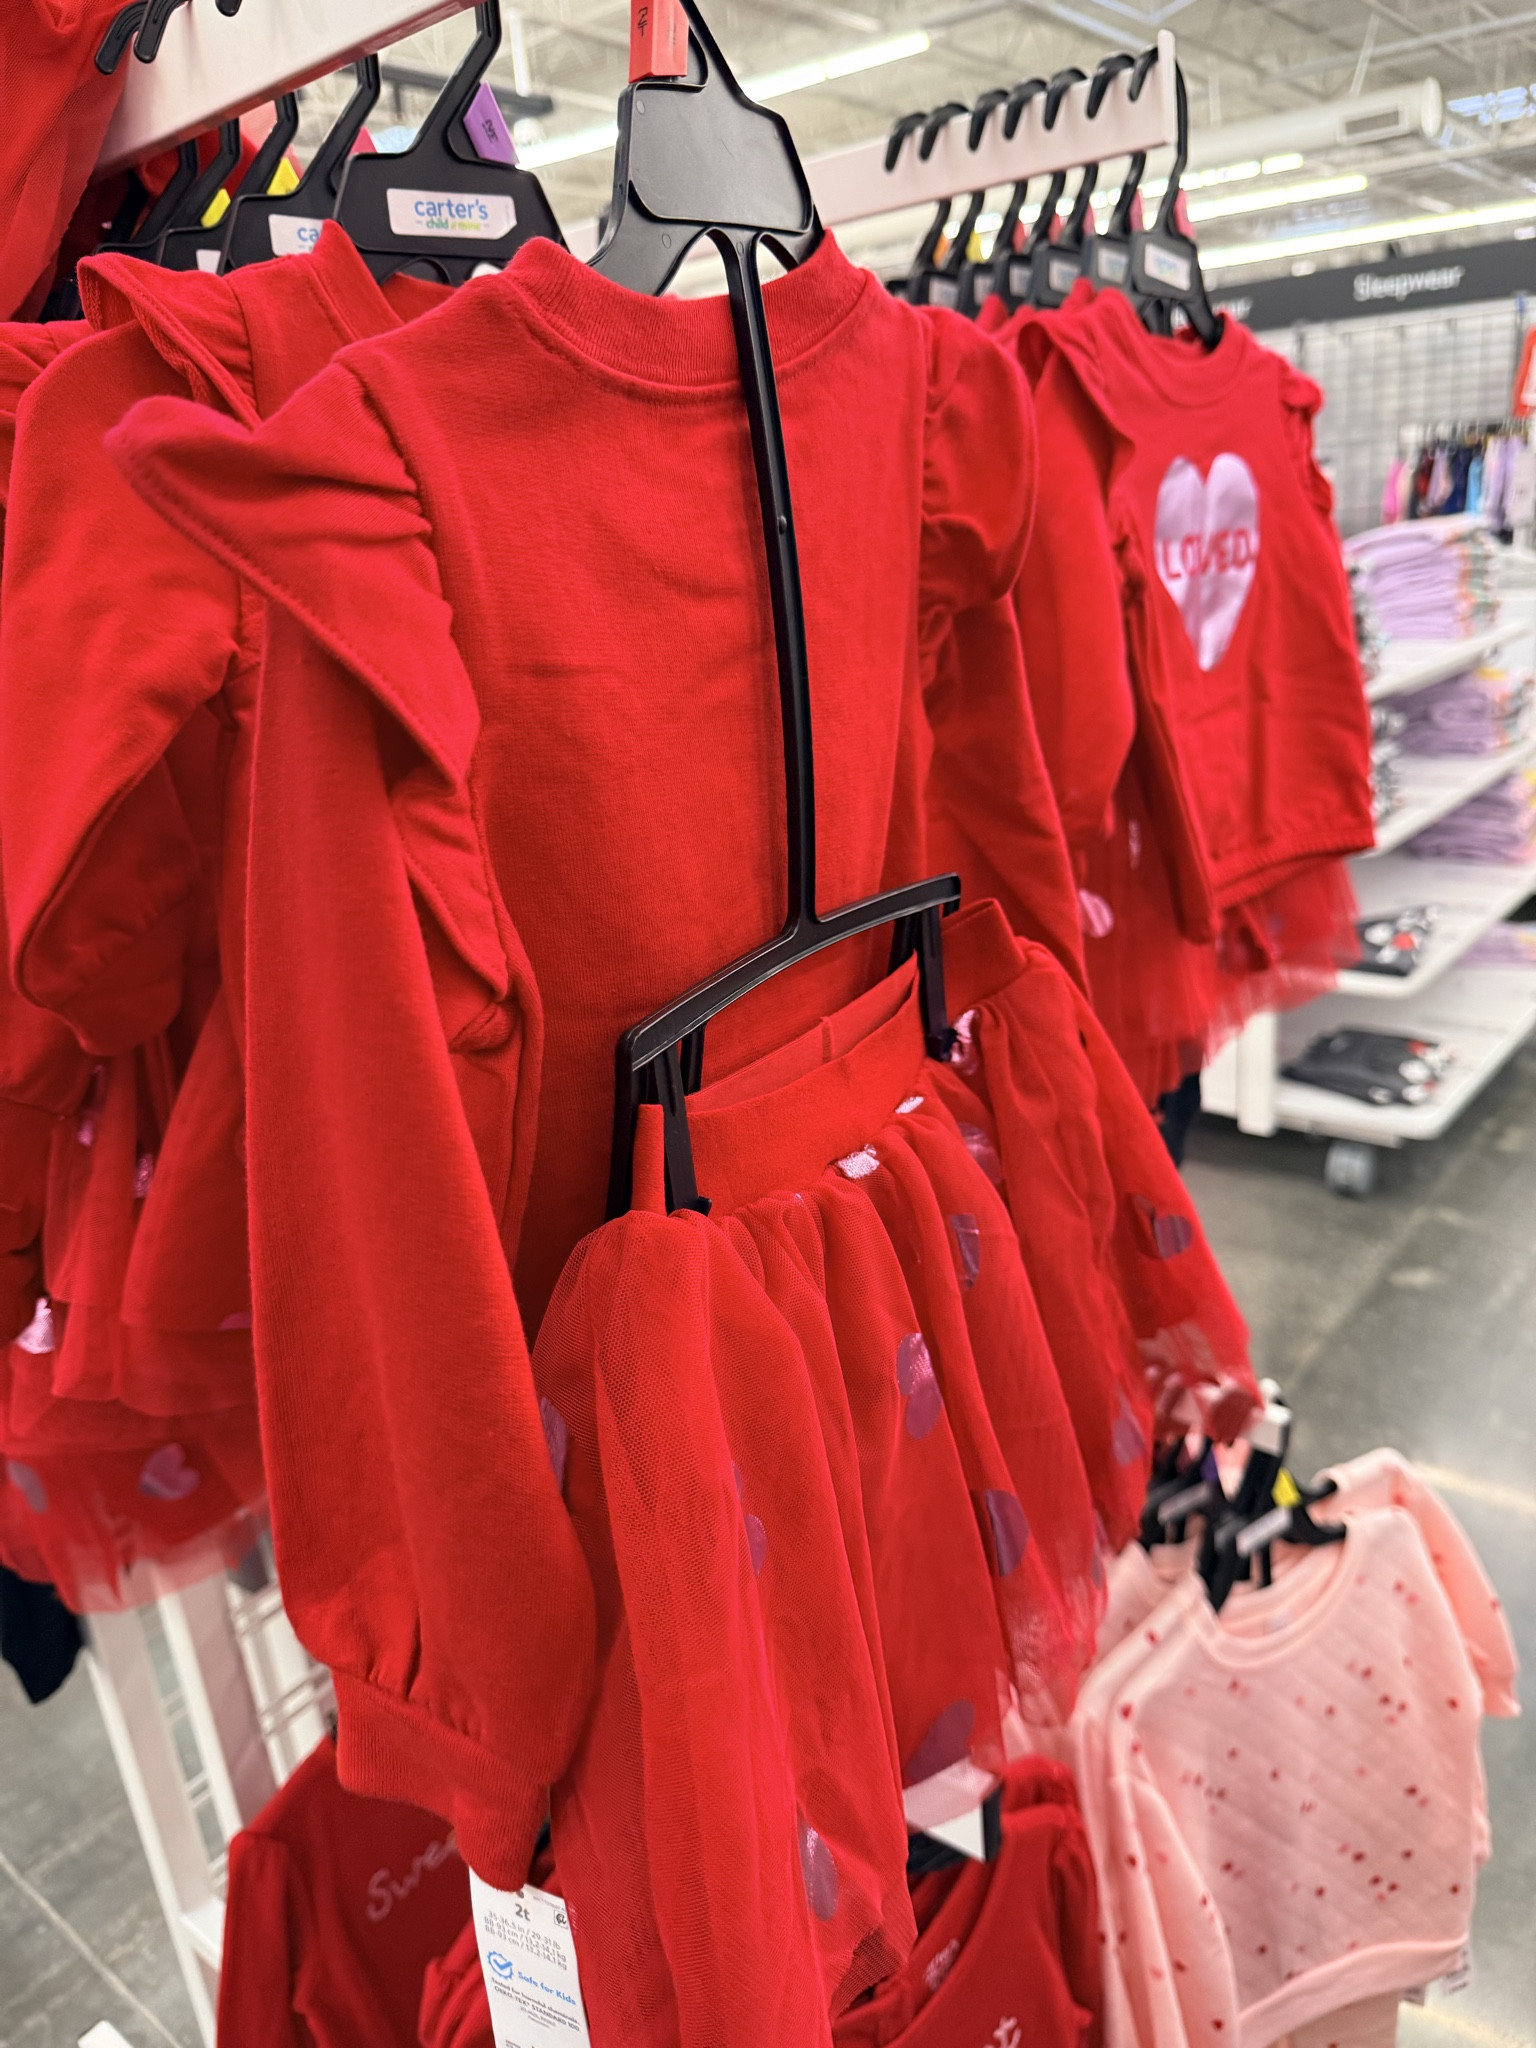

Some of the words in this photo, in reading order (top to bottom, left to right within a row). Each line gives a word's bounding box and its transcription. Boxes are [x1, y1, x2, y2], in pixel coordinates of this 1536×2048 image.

[414, 198, 489, 221] carter's
[426, 217, 449, 230] child
[1354, 266, 1467, 302] Sleepwear
[515, 1903, 531, 1922] 2t
[518, 1971, 538, 1988] Safe
[540, 1982, 554, 1994] for
[555, 1989, 576, 2005] Kids
